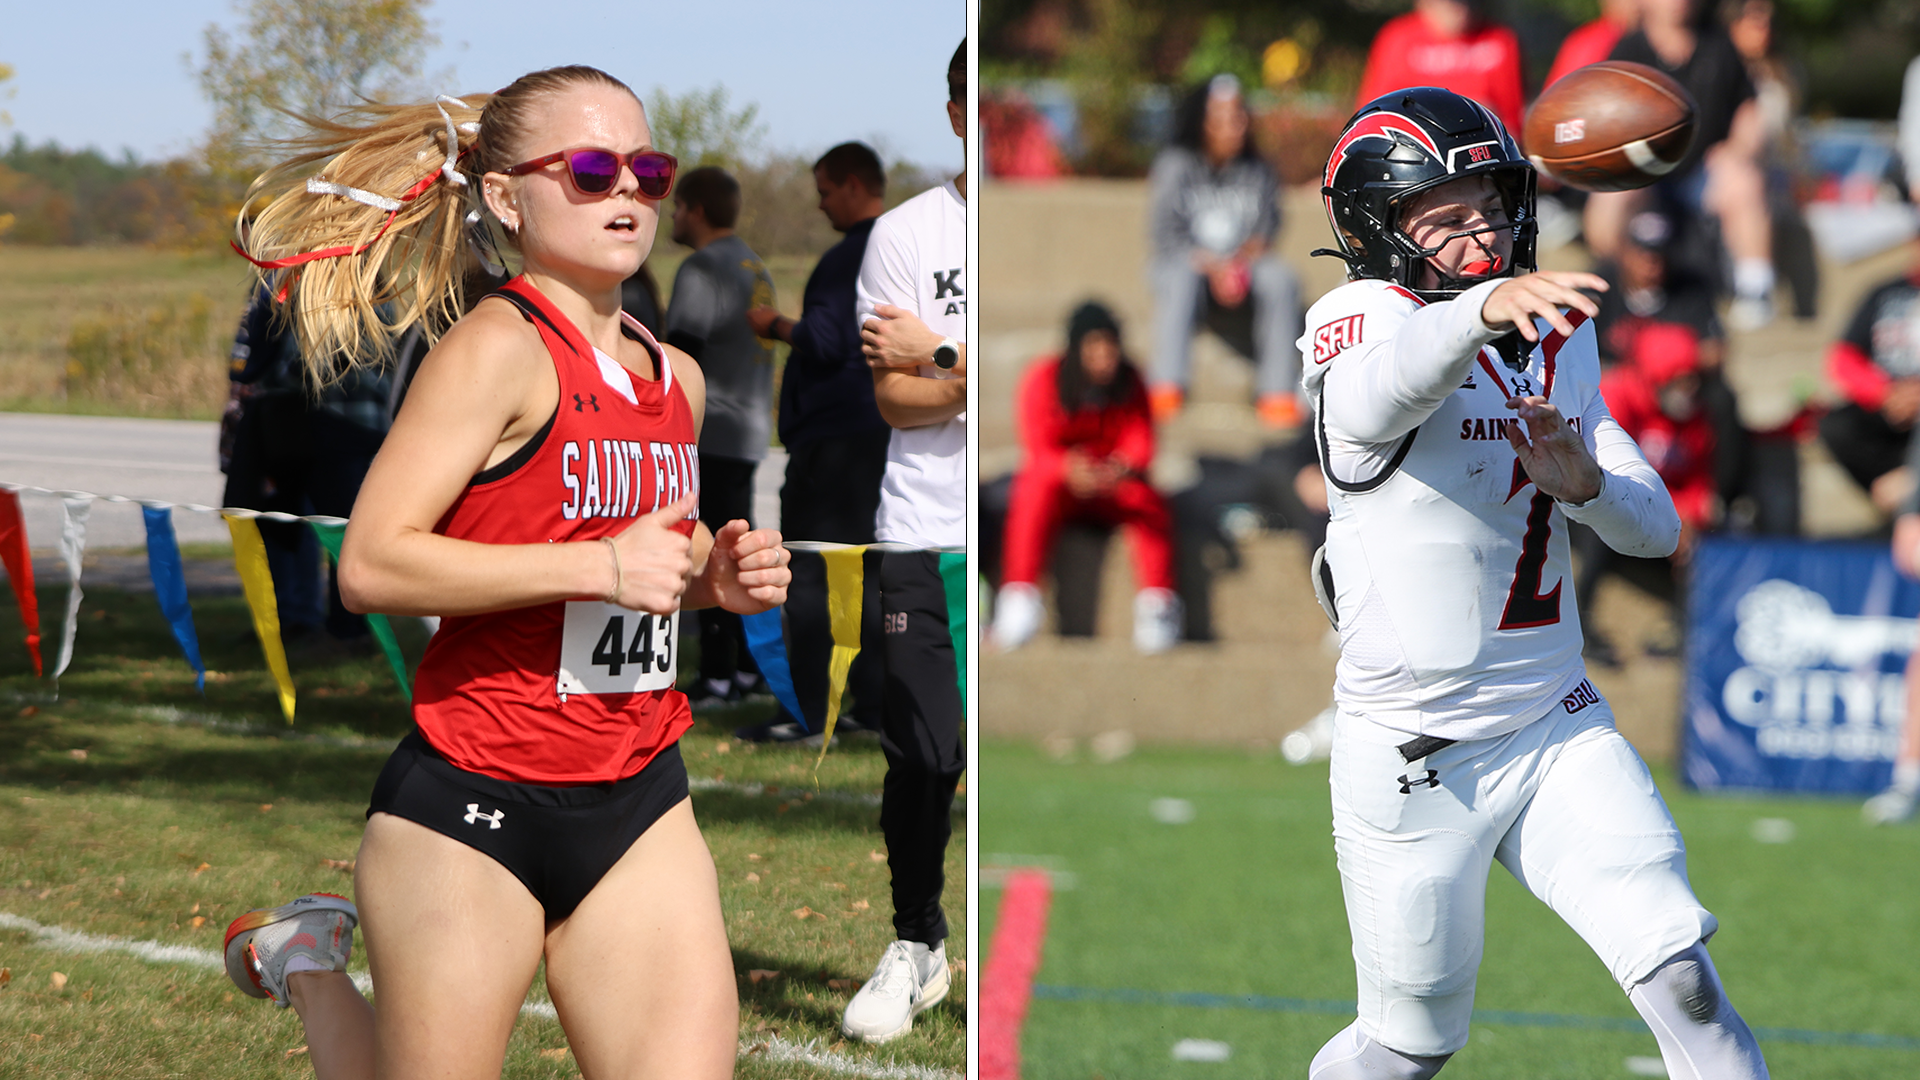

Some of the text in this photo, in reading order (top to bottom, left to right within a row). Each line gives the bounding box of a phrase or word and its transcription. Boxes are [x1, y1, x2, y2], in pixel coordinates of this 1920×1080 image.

[1468, 145, 1492, 162] SFU
[1313, 313, 1365, 365] SFU
[561, 439, 700, 520] SAINT FRAN
[1497, 457, 1562, 630] 2
[592, 614, 672, 676] 443
